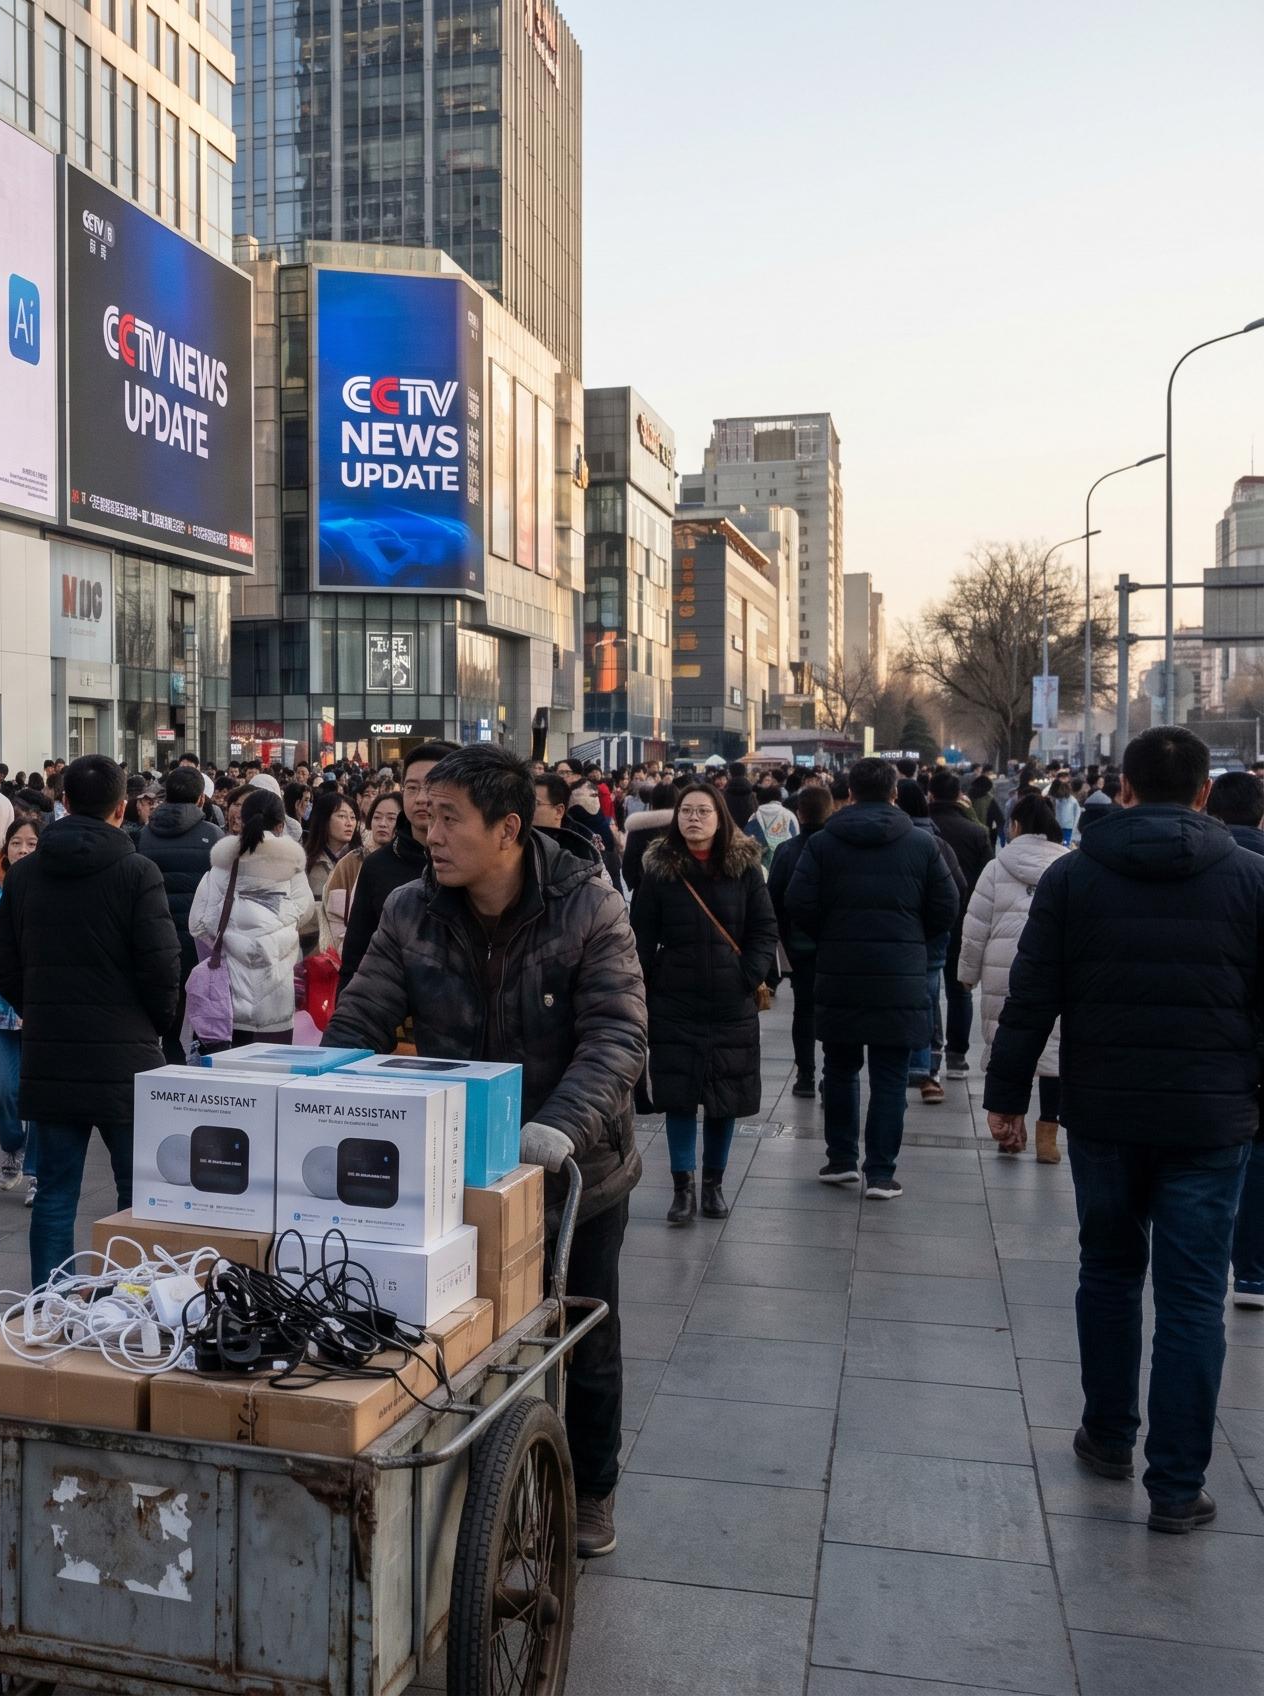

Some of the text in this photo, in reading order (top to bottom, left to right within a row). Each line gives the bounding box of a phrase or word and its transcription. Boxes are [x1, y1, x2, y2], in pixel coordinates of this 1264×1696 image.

[14, 297, 34, 347] Ai
[103, 305, 228, 408] CCTV NEWS
[342, 375, 459, 417] CCTV
[124, 379, 209, 460] UPDATE
[341, 421, 459, 459] NEWS
[341, 461, 459, 491] UPDATE
[150, 1090, 257, 1108] SMART AI ASSISTANT
[294, 1102, 408, 1121] SMART AI ASSISTANT
